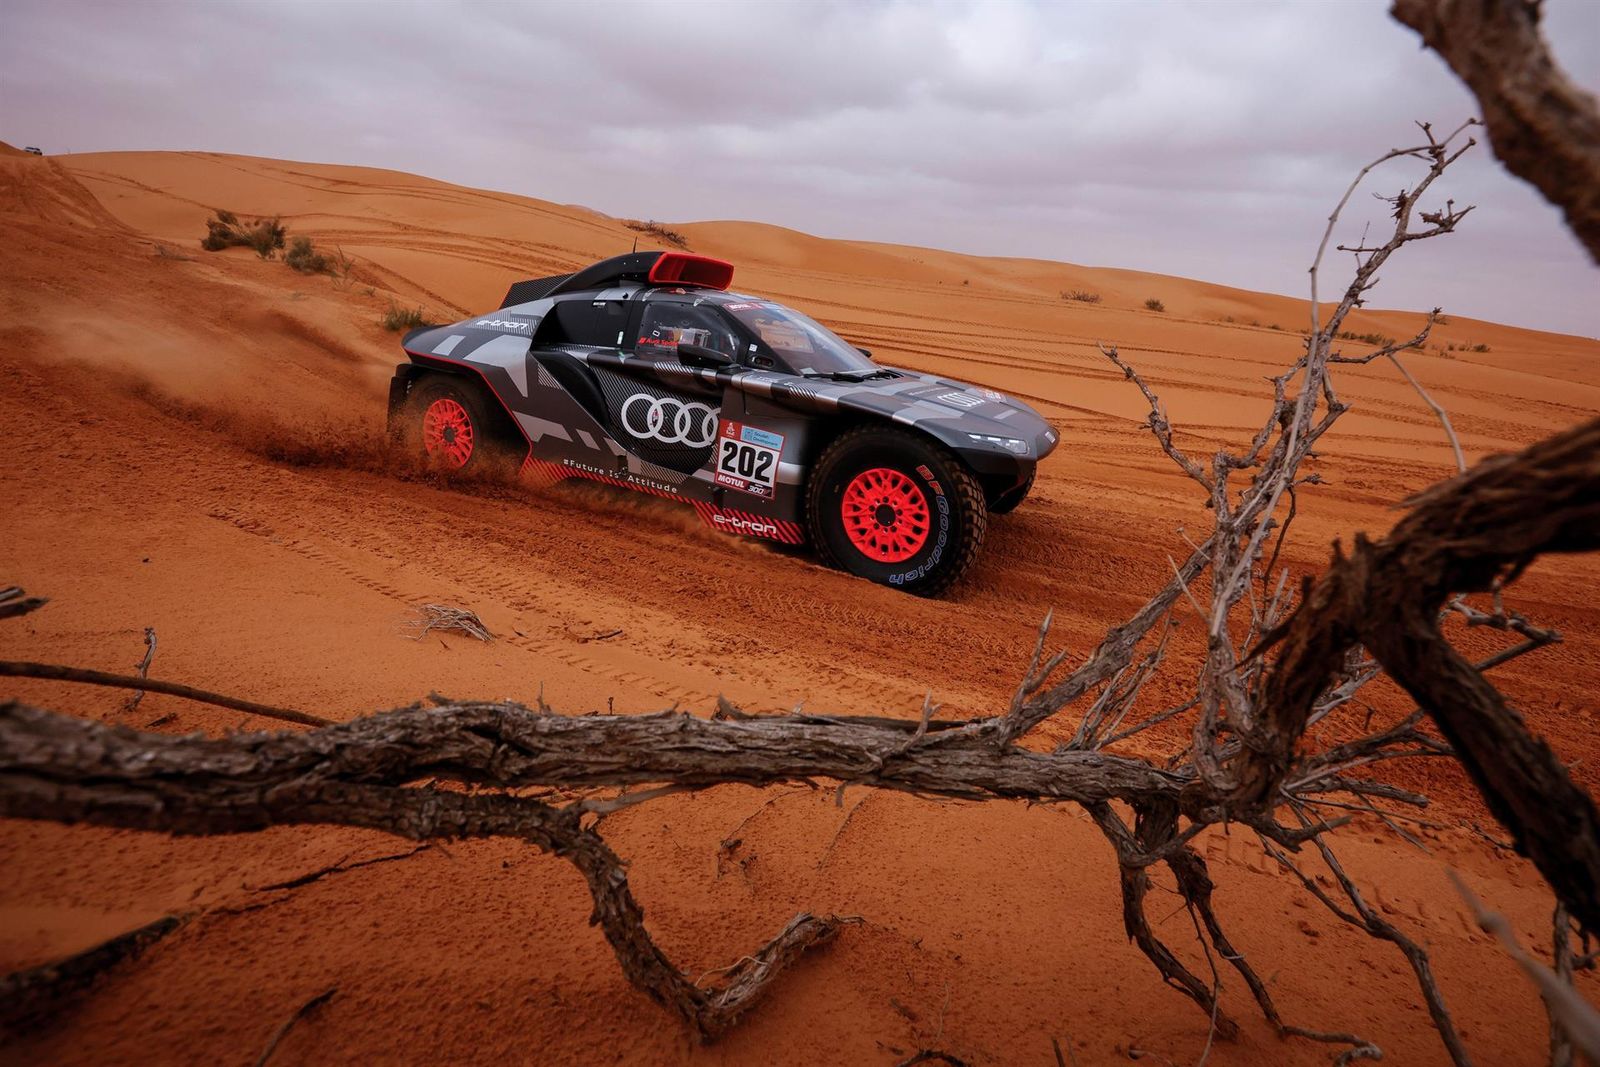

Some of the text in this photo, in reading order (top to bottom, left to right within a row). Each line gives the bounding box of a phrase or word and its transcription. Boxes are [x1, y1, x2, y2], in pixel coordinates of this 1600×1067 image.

[476, 319, 529, 330] e-tron
[563, 458, 605, 475] #Future
[627, 474, 678, 494] Attitude
[721, 441, 773, 483] 202
[718, 474, 745, 488] MOTUL
[713, 514, 777, 534] e-tron
[889, 464, 950, 585] BFGoodrich
